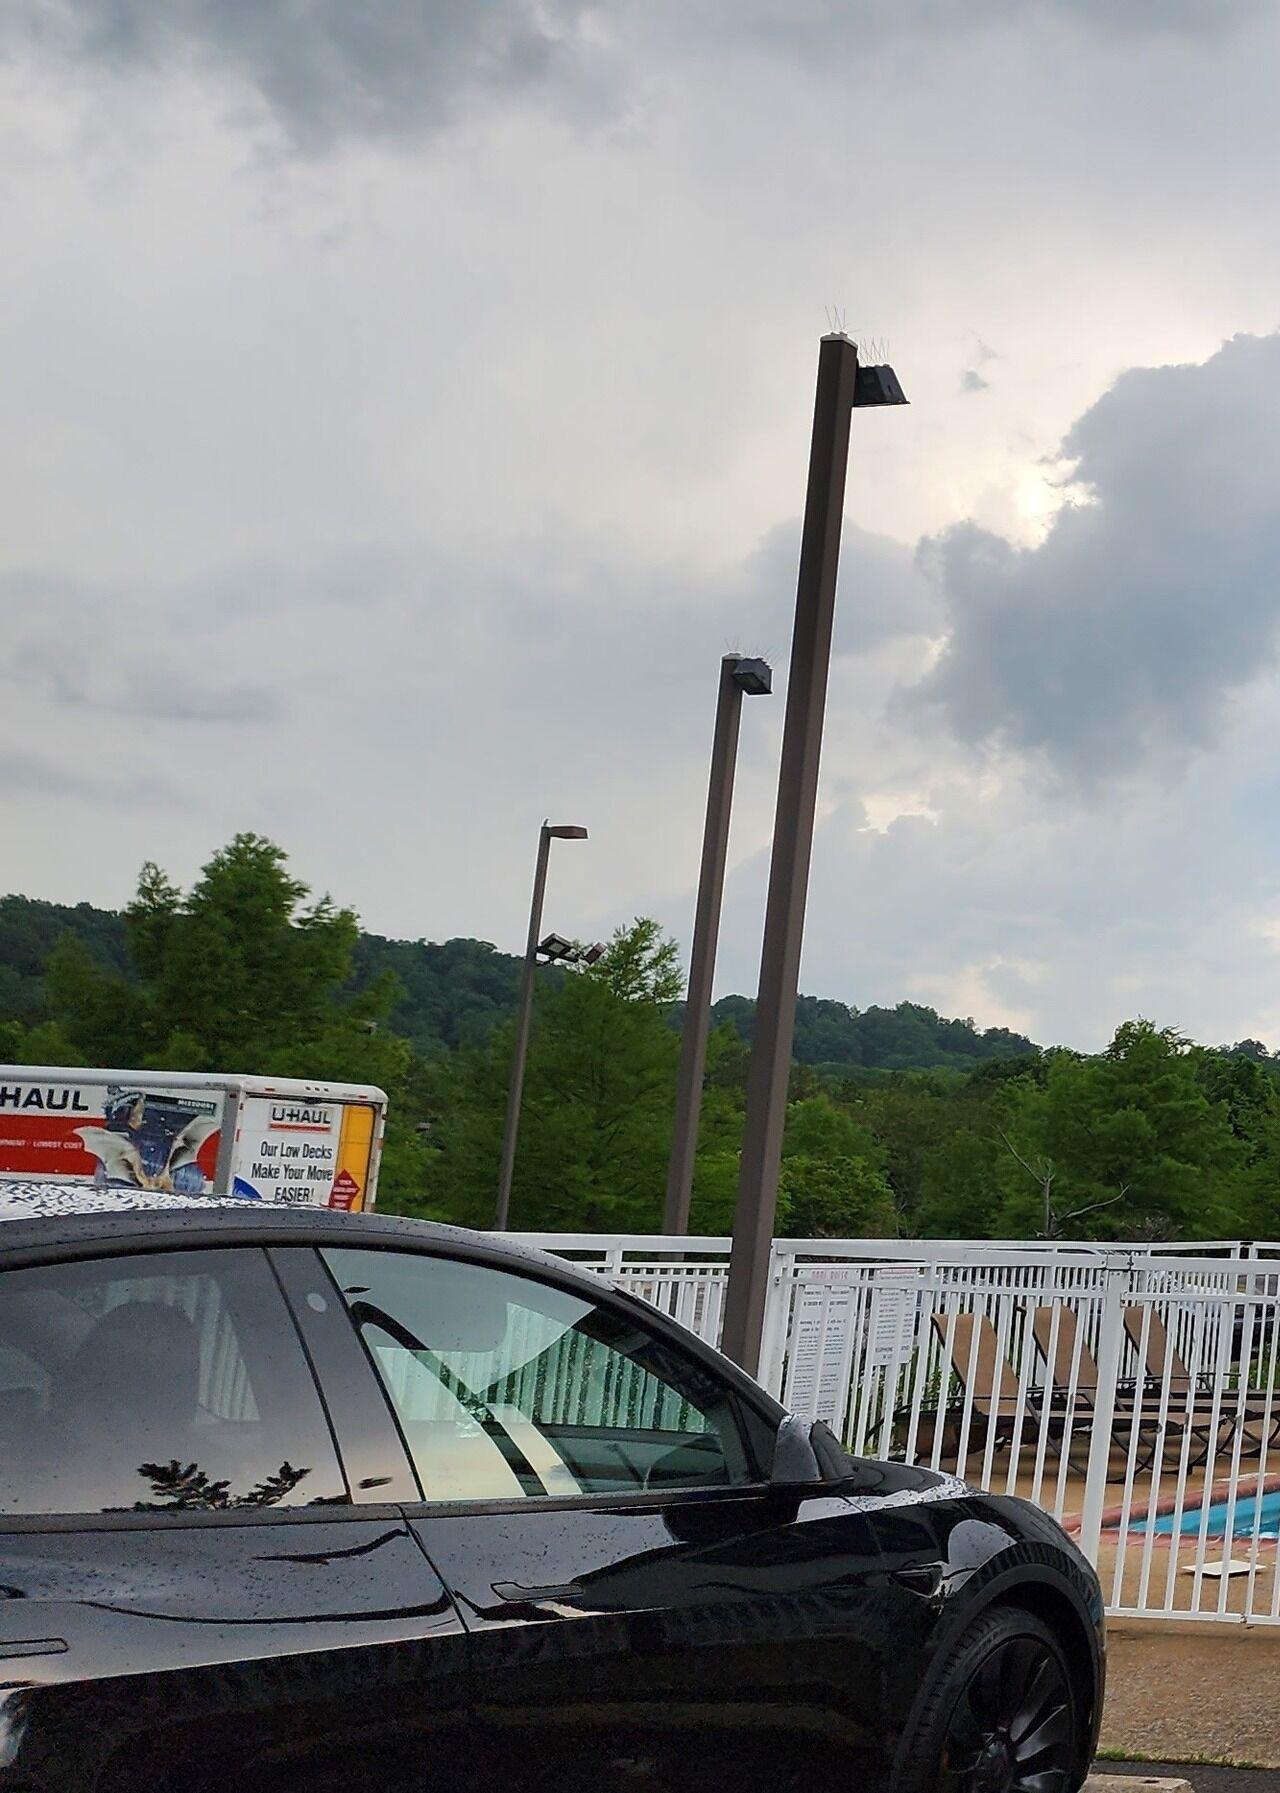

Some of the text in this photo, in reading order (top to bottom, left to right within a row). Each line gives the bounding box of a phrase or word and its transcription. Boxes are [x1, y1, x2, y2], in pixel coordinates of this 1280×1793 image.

[260, 1141, 332, 1159] Our Low Decks
[251, 1163, 333, 1181] Make Your Move
[275, 1187, 315, 1203] EASIER!
